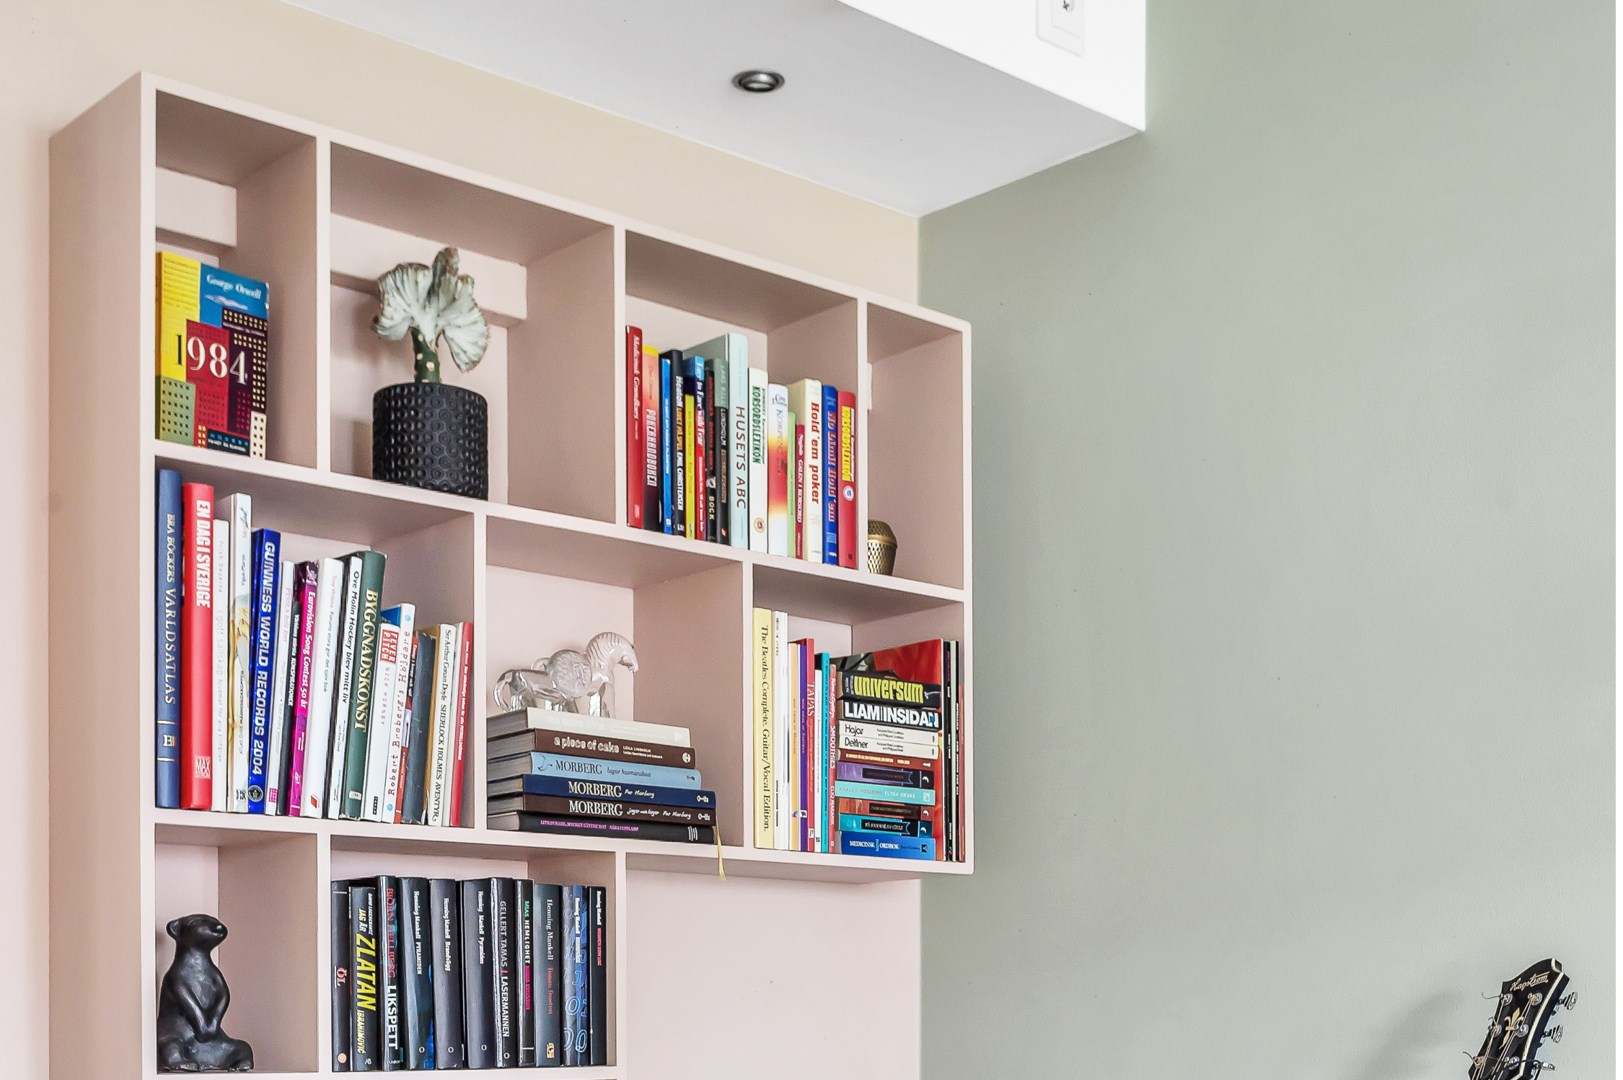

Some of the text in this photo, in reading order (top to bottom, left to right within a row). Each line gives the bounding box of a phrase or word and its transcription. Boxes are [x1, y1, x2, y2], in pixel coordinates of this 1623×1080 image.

[175, 333, 248, 385] 1984
[752, 385, 762, 464] KORSORDSLEXIKON
[810, 402, 821, 434] Hold
[735, 405, 747, 510] HUSETS ABC
[808, 464, 821, 504] poker
[166, 513, 176, 534] BRA
[195, 499, 211, 518] EN
[195, 519, 211, 546] DAG
[195, 552, 211, 609] SVERIGE
[305, 590, 316, 633] Eurovision
[302, 634, 313, 655] Song
[341, 570, 360, 704] Ove Molin Hockey blev mitt liv
[381, 631, 392, 662] PITCH
[388, 632, 399, 663] FEVER
[443, 640, 452, 662] Arthur
[760, 625, 769, 645] The
[252, 541, 276, 776] GUINNESS WORLD RECORDS 2004
[301, 656, 312, 687] Contest
[353, 588, 379, 734] BYGGNADSKONST
[760, 645, 769, 681] Beatles
[807, 682, 815, 717] TAPAS
[853, 675, 924, 704] universum
[437, 703, 448, 746] SHERLOCK
[553, 735, 561, 747] a
[586, 739, 598, 751] of
[387, 754, 399, 798] Robert
[435, 746, 445, 780] HOLMES
[554, 758, 603, 775] MORBERG
[761, 728, 772, 793] Guitar/Vocal
[567, 780, 623, 799] MORBERG
[568, 799, 624, 817] MORBERG
[412, 890, 421, 916] Henning
[545, 898, 553, 931] Henning
[414, 915, 422, 940] Mankell
[546, 931, 554, 961] Mankell
[336, 966, 347, 987] ÖL
[355, 933, 377, 1012] ZLATAN
[499, 900, 510, 1038] GELLERT TAMAS LASERMANNEN
[386, 984, 399, 1051] LIKSPETT
